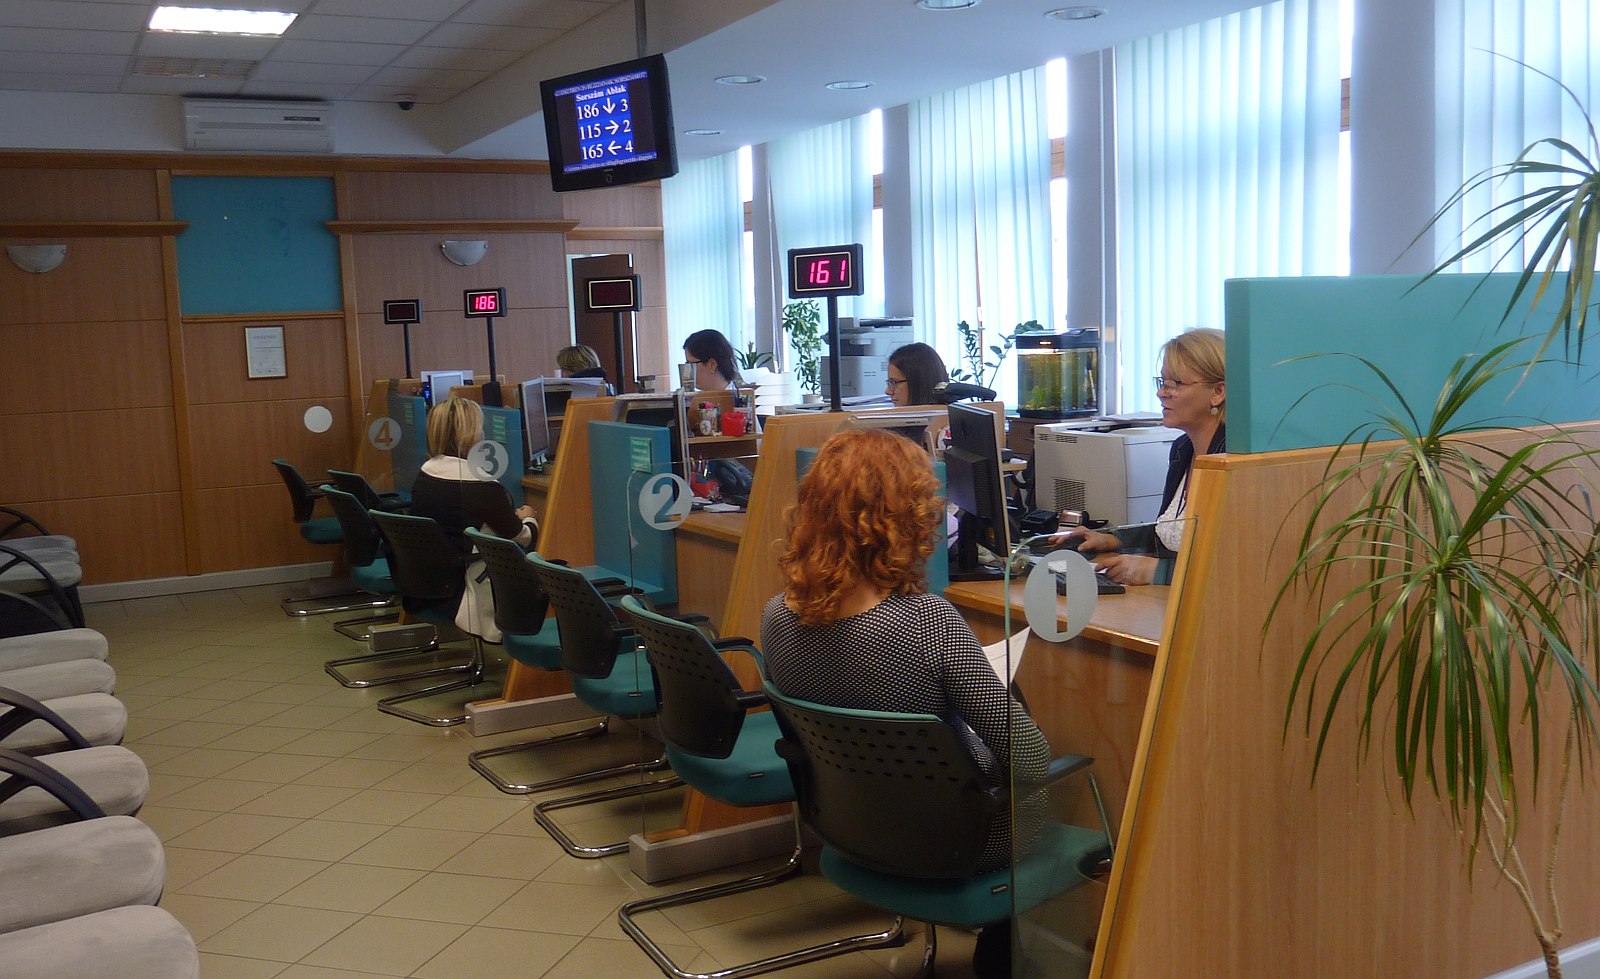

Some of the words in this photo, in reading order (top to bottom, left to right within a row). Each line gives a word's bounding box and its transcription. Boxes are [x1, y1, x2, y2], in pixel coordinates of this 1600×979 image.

[576, 91, 604, 102] Sorszám
[605, 85, 626, 96] Ablak
[577, 103, 599, 120] 186
[621, 99, 628, 112] 3
[580, 124, 601, 140] 115
[623, 120, 631, 132] 2
[582, 144, 603, 160] 165
[625, 140, 633, 153] 4
[809, 260, 847, 283] 161
[475, 295, 496, 310] 186
[374, 420, 393, 447] 4
[477, 442, 500, 476] 3
[651, 476, 682, 525] 2
[1047, 559, 1068, 634] 1
